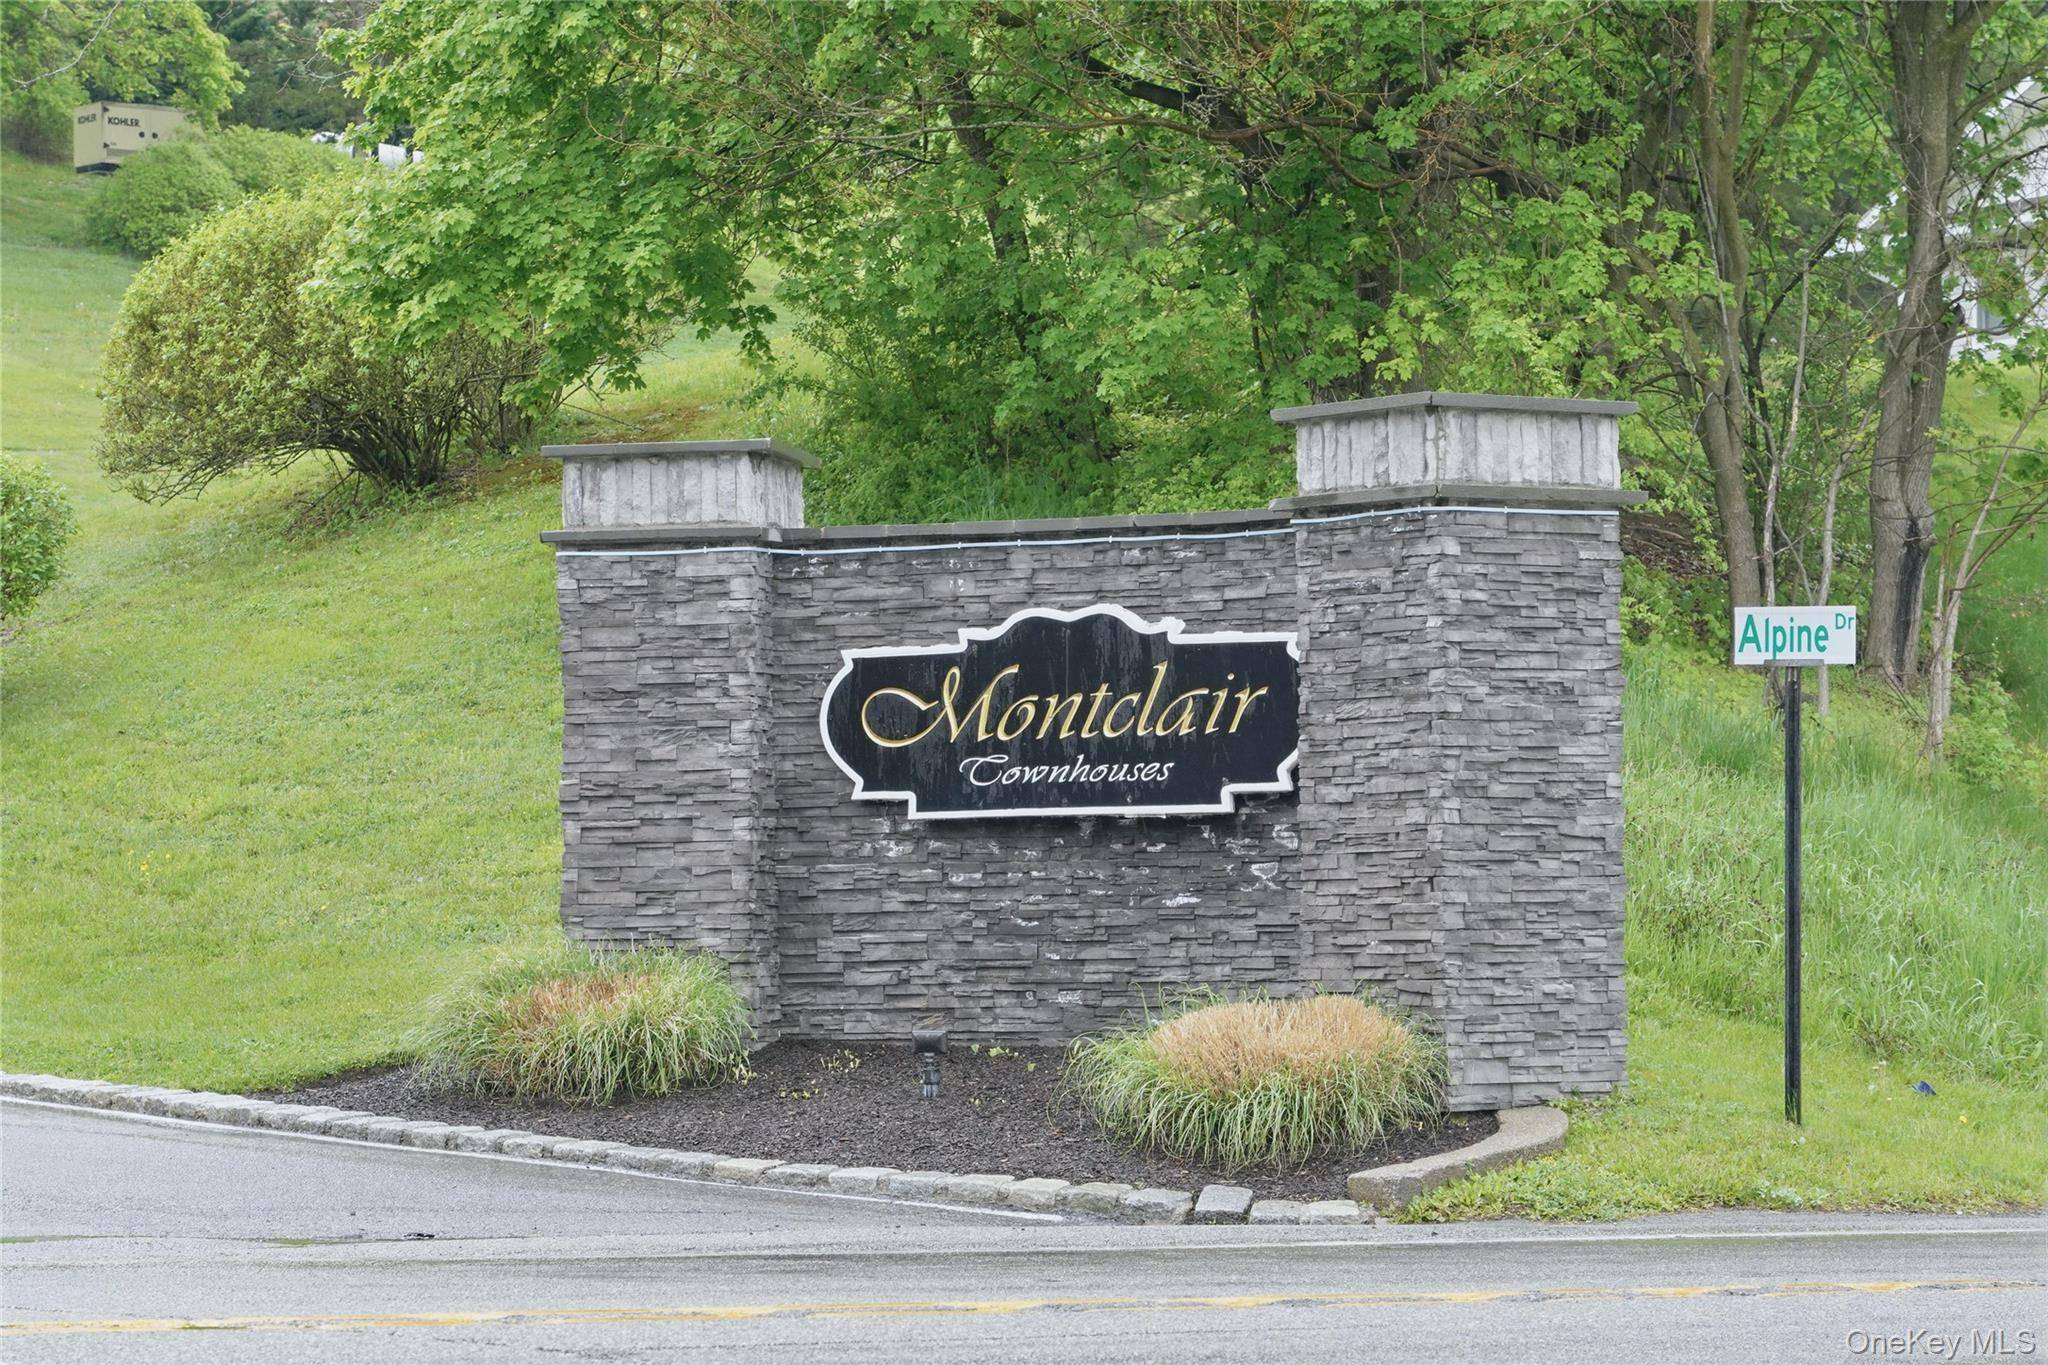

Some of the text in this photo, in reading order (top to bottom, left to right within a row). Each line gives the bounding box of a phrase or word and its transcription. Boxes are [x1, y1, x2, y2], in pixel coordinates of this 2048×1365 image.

[107, 117, 141, 128] KOHLER
[1738, 613, 1855, 660] Alpine Dr
[861, 660, 1269, 748] Montclair
[959, 754, 1175, 787] Townhouses
